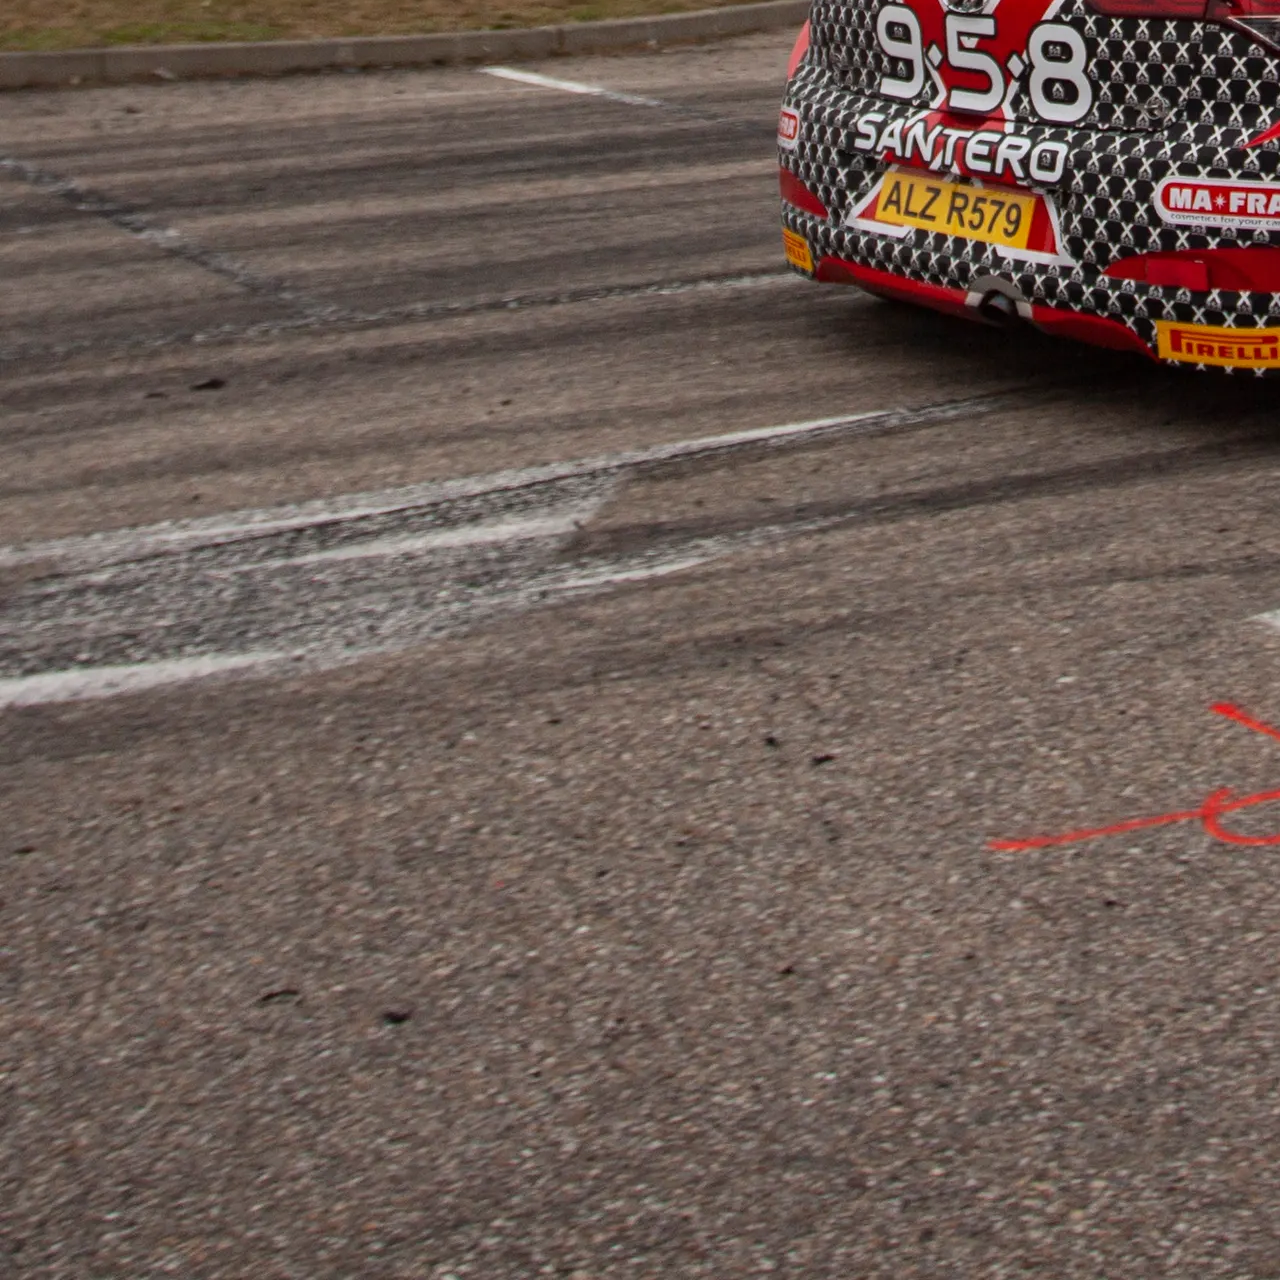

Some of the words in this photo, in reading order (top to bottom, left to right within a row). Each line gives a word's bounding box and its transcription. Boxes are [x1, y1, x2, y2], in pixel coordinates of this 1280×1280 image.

[854, 113, 1069, 184] SANTERO
[882, 180, 942, 222] ALZ
[946, 193, 1022, 239] R579
[1170, 212, 1217, 223] cosmetics
[1220, 216, 1236, 224] for
[1238, 217, 1262, 227] your
[1169, 328, 1280, 361] PIRELLI
